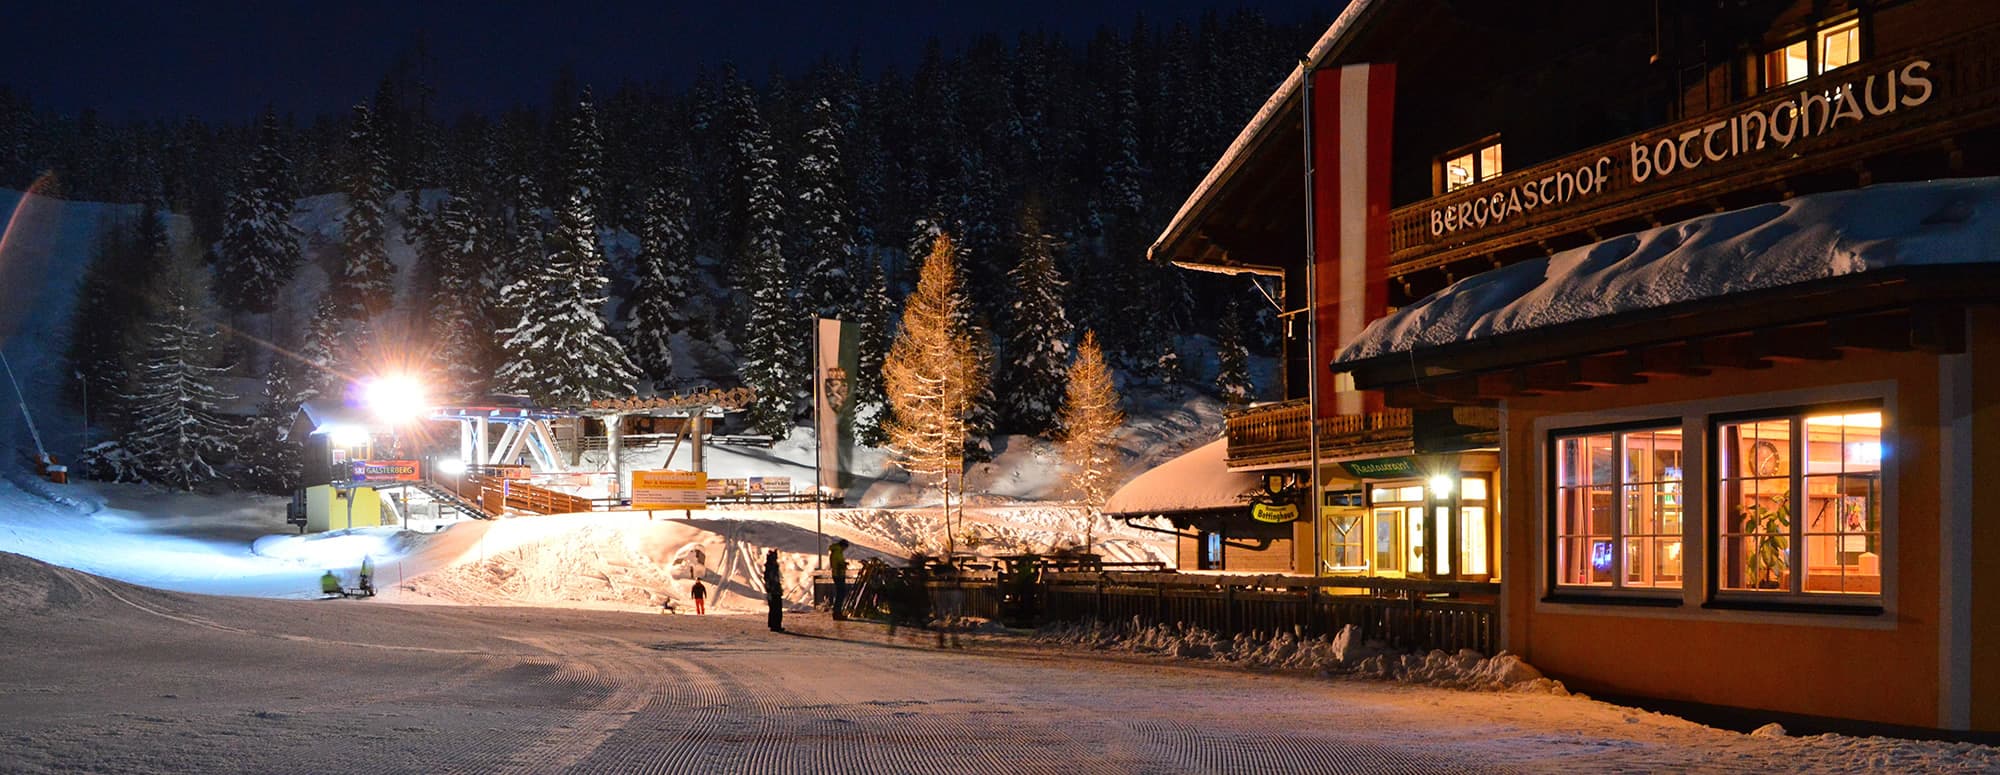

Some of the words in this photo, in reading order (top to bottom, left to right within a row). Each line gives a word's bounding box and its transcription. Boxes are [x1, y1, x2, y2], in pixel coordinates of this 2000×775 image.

[1431, 156, 1611, 236] BERGGASTHOF
[1631, 60, 1933, 184] BOTTINGHAUS
[366, 466, 413, 474] GALSTERBERG
[1351, 461, 1410, 474] Restaurant
